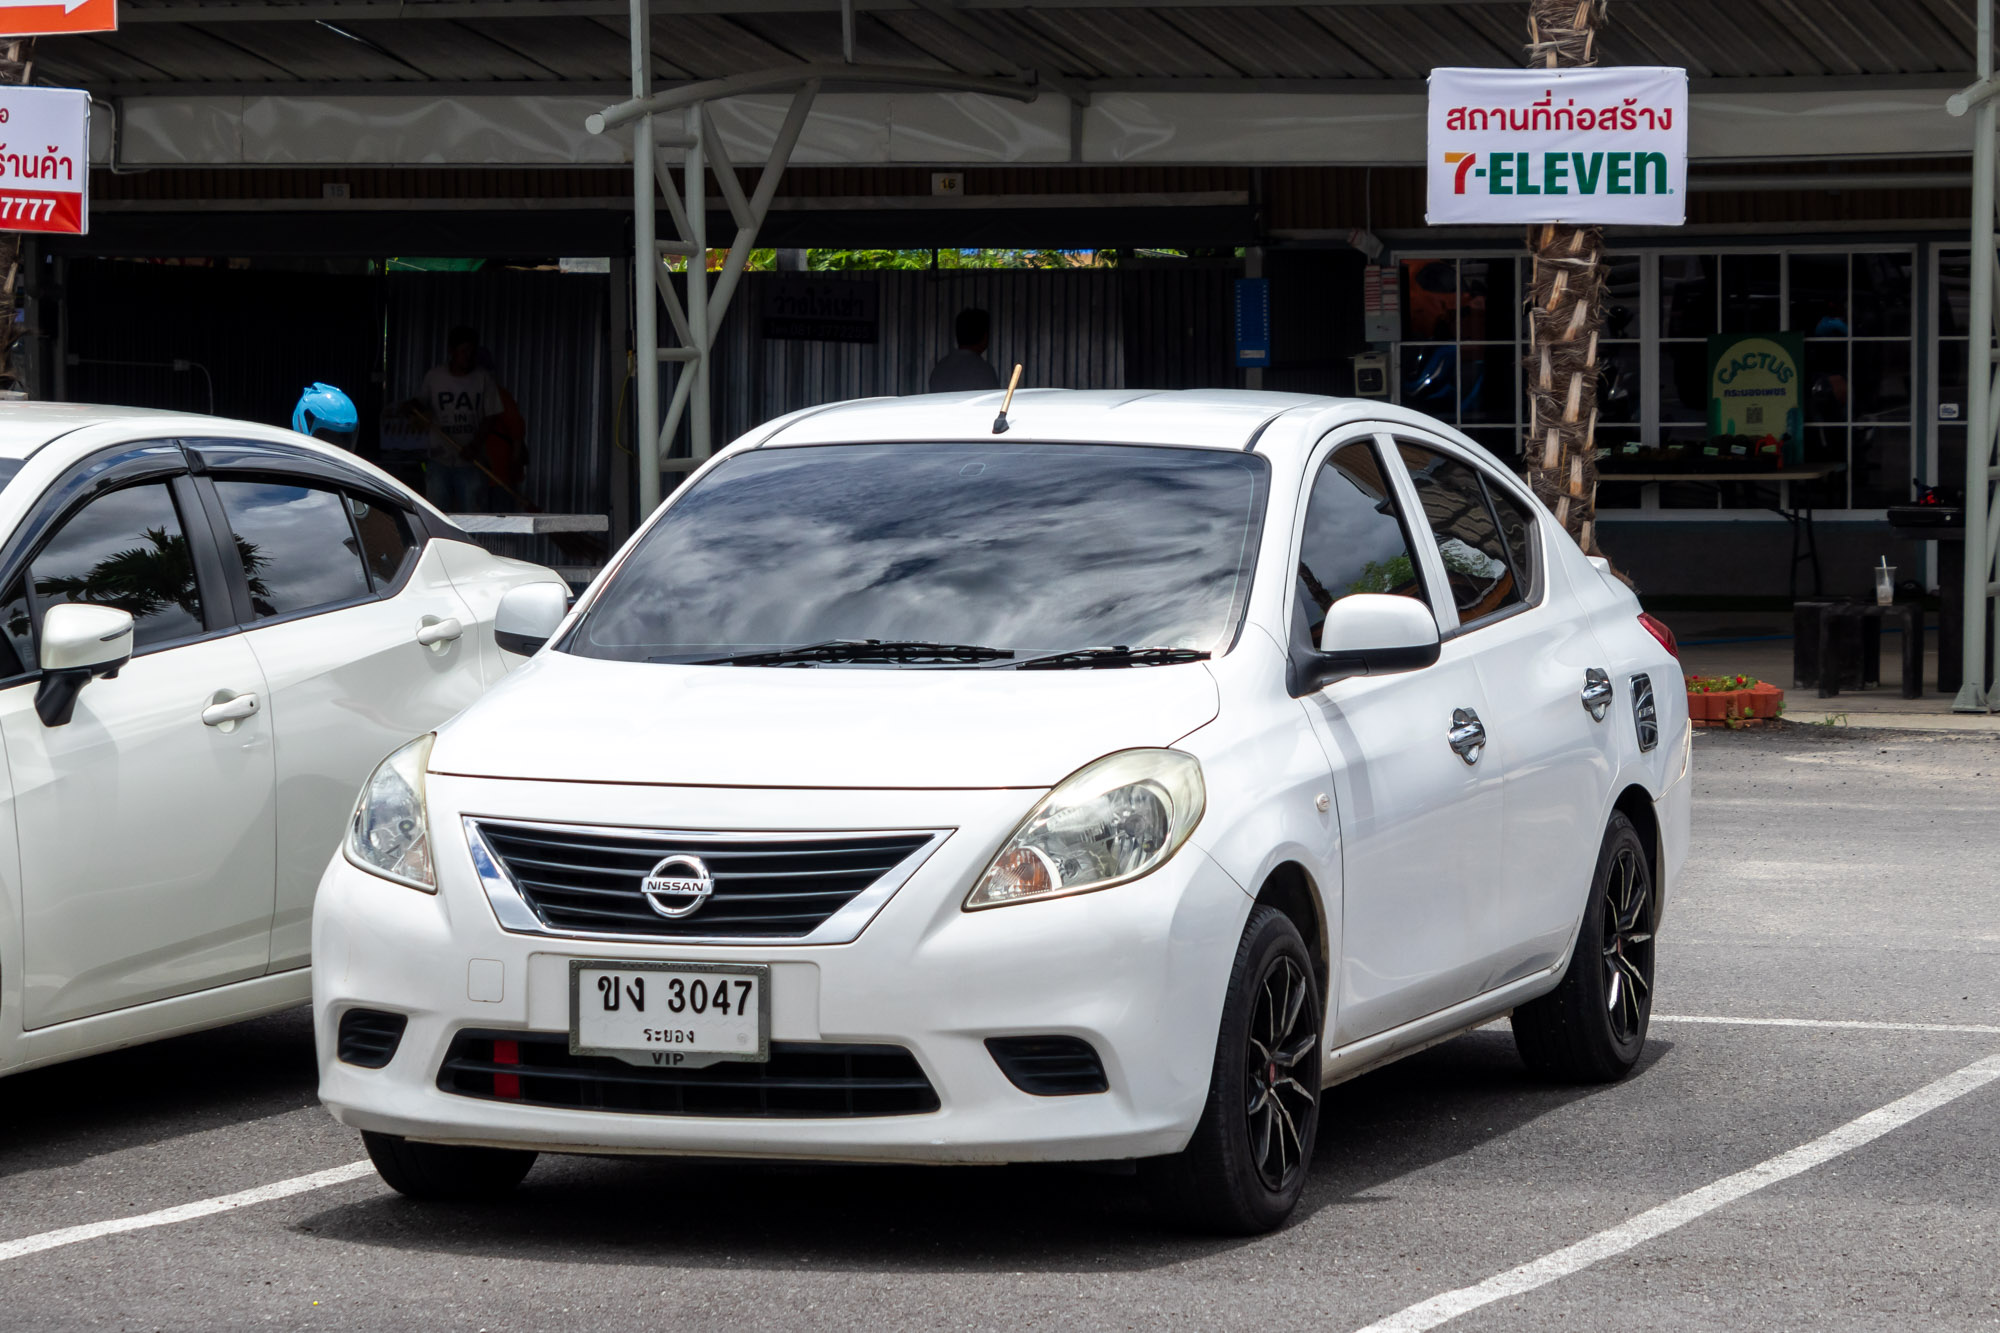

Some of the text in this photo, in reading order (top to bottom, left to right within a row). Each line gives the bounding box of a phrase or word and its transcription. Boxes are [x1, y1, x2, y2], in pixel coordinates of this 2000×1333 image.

[1446, 90, 1672, 131] สถานที่ก่อสร้าง
[1, 197, 56, 221] 7777
[1717, 351, 1794, 384] CACTUS
[438, 392, 480, 410] PAI
[454, 414, 467, 423] IN
[647, 880, 704, 892] NISSAN
[597, 975, 753, 1016] ขง 3047
[643, 1028, 695, 1044] ระยอง
[652, 1052, 685, 1066] VIP
